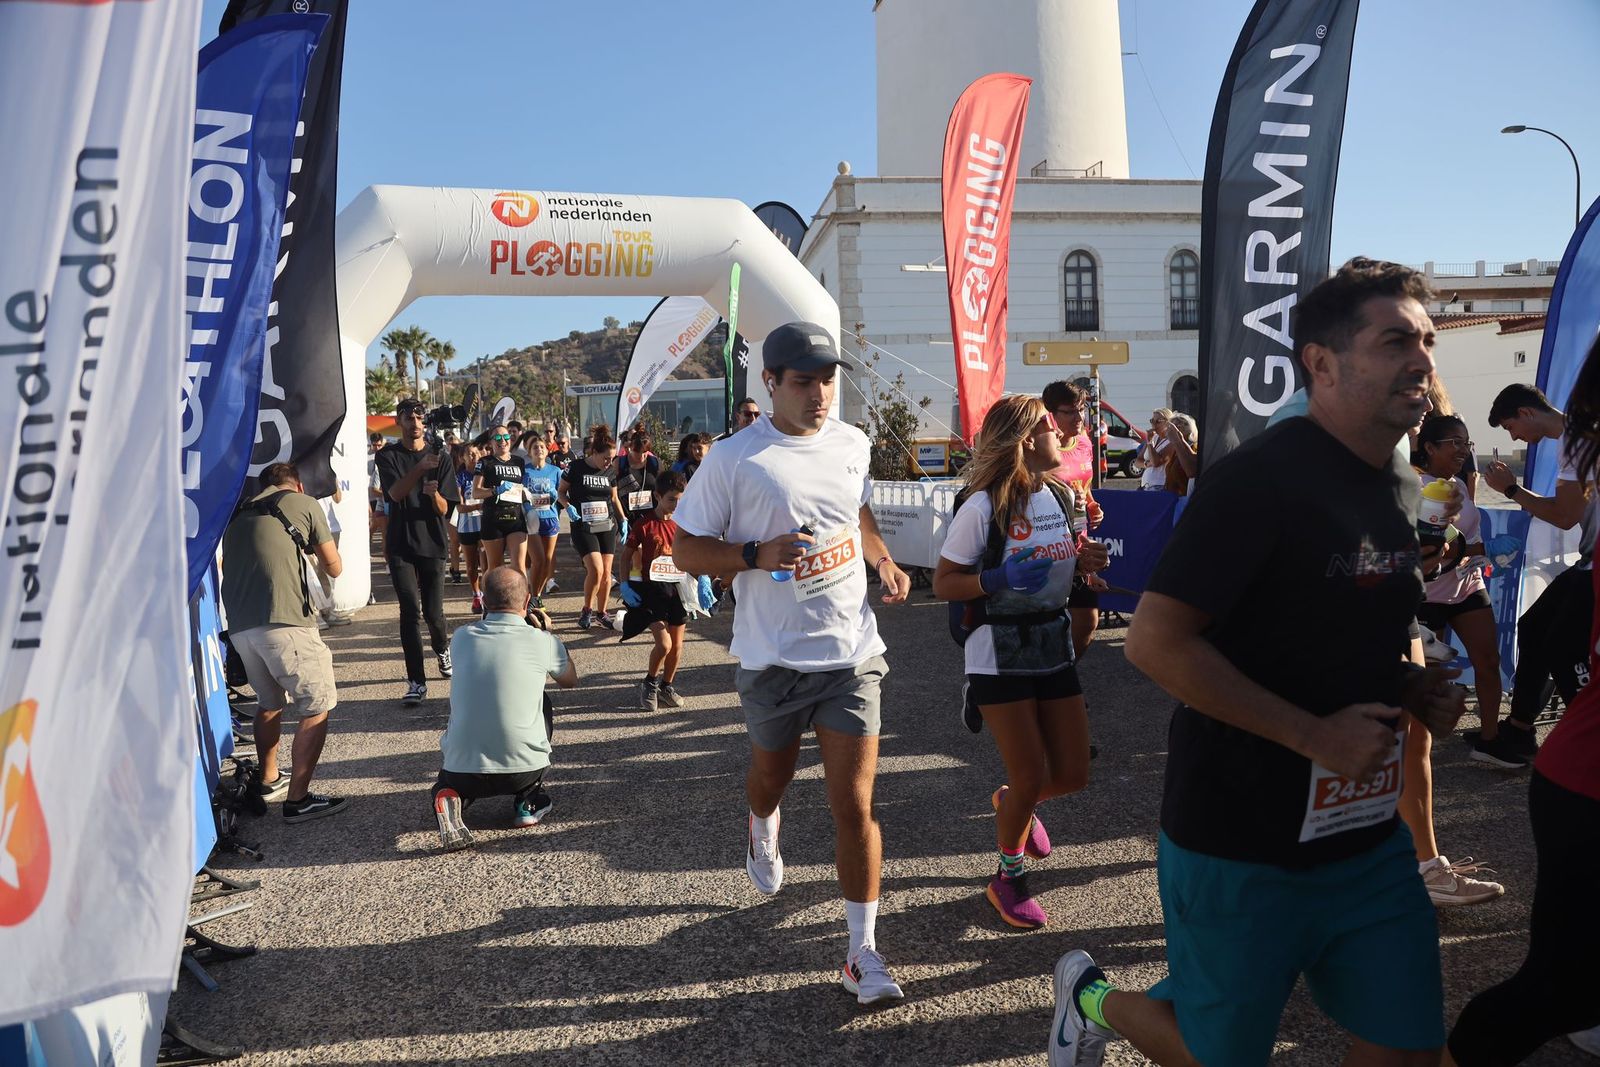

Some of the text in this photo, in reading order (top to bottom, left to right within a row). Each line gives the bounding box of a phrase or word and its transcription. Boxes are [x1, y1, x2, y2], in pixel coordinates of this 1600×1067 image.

[547, 197, 624, 208] nationale
[549, 208, 653, 222] nederlanden
[613, 230, 653, 243] TOUR
[1238, 43, 1321, 417] GARMIN
[490, 239, 655, 278] PLOGGING
[1033, 511, 1062, 523] nationale
[799, 542, 852, 577] 24376
